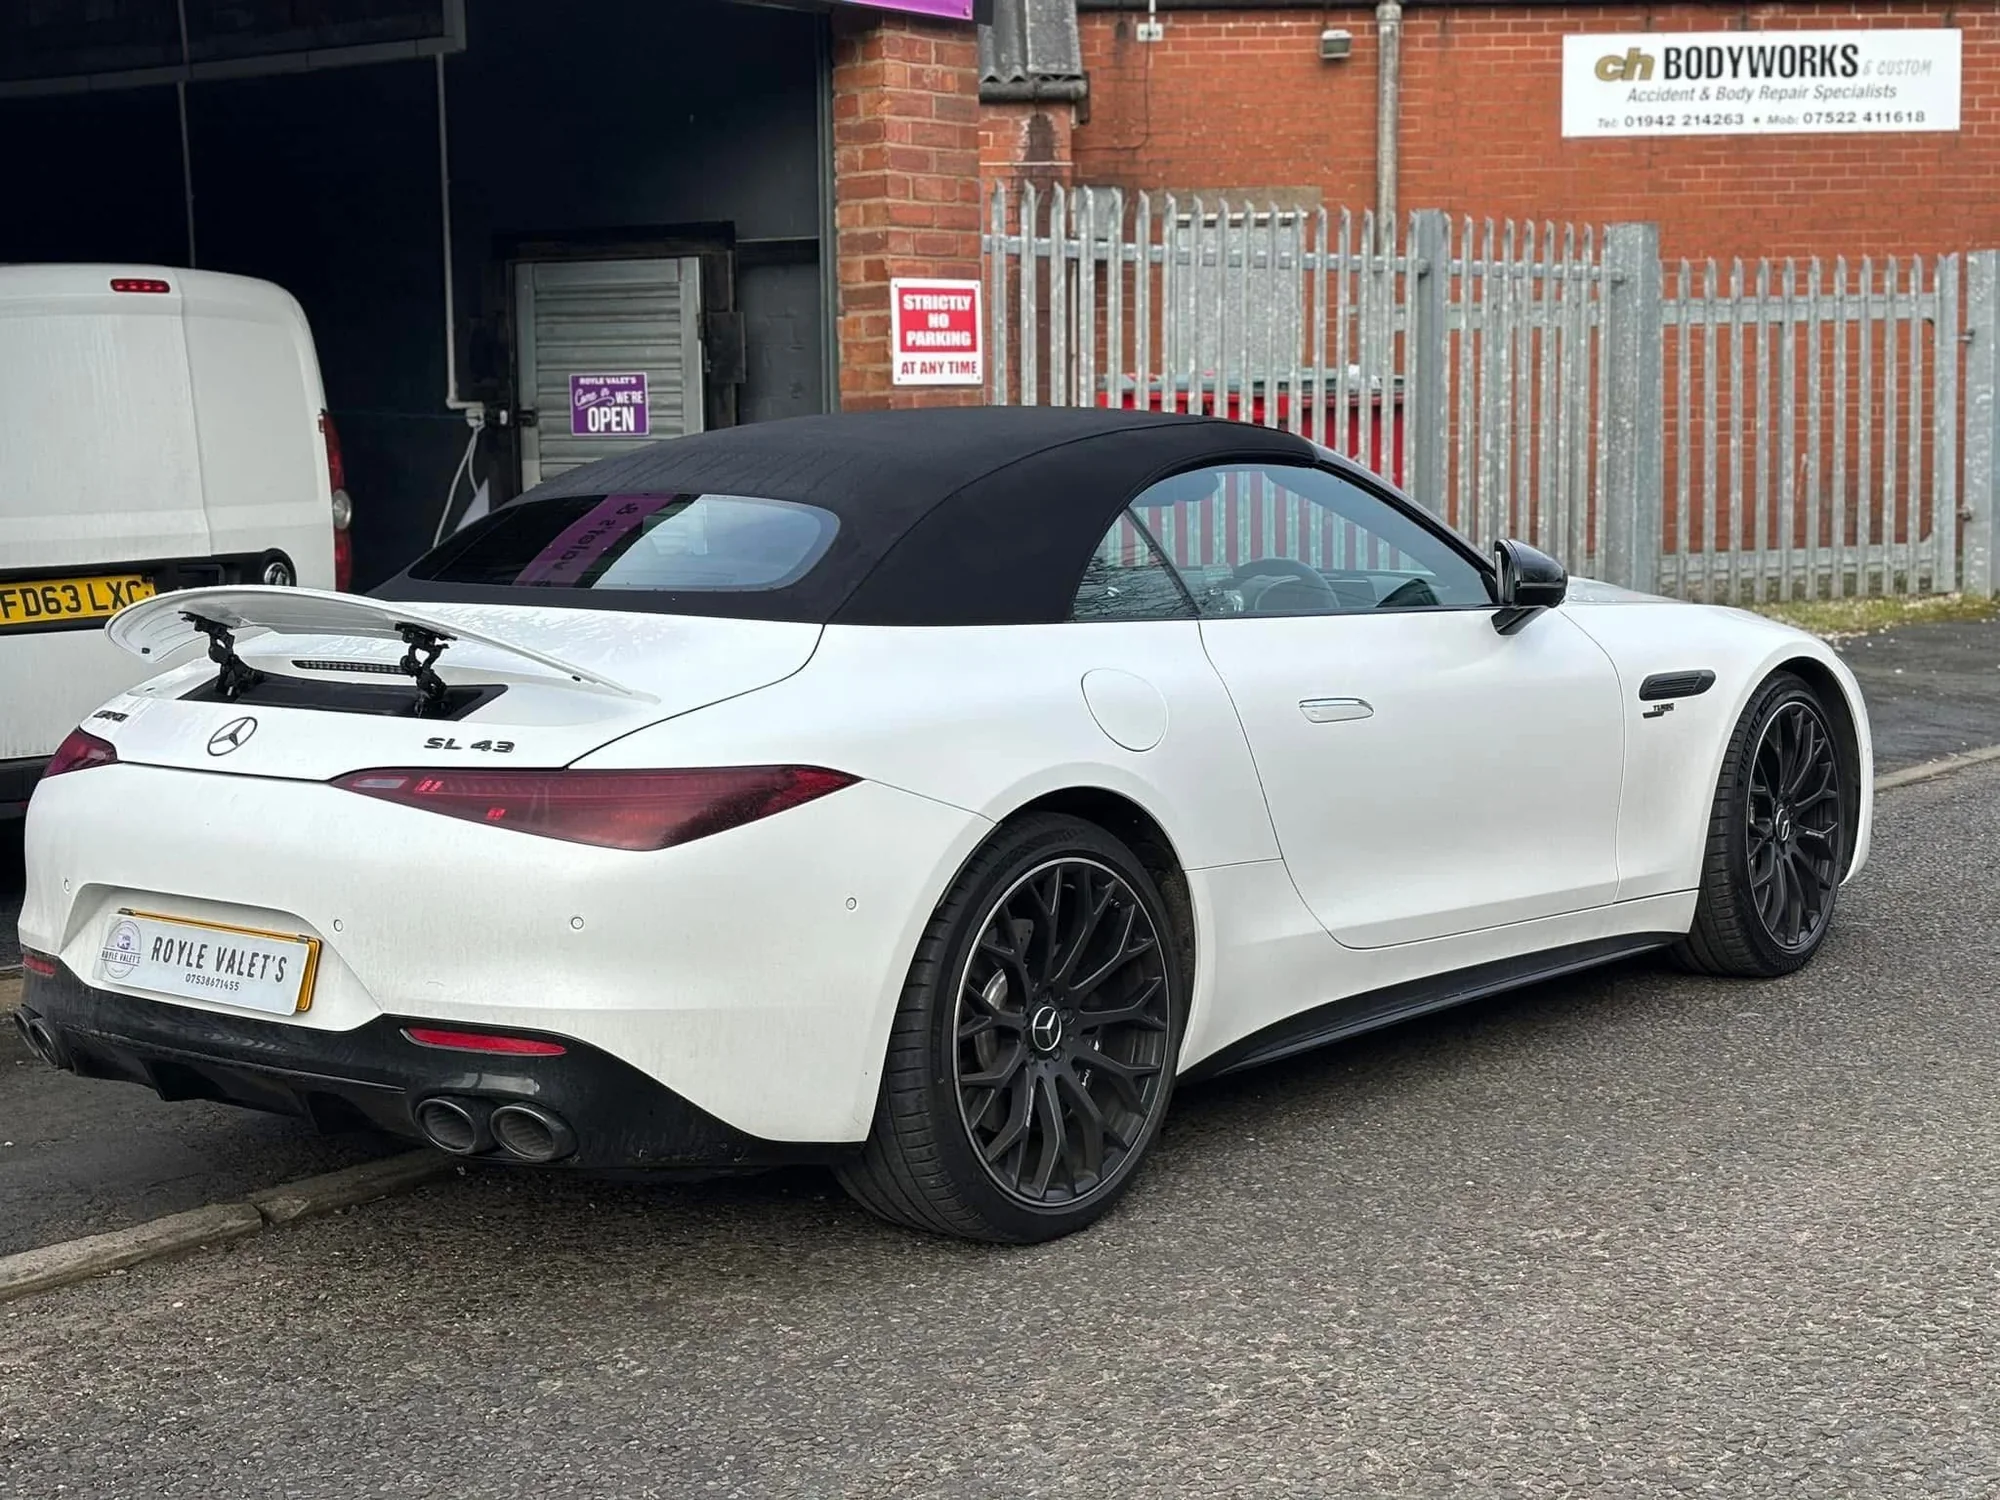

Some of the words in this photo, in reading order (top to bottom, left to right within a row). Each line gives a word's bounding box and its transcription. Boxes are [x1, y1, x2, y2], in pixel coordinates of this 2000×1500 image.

[1594, 47, 1656, 82] ch
[1663, 43, 1859, 81] BODYWORKS
[1877, 59, 1933, 76] CUSTOM
[1627, 87, 1696, 102] Accident
[1699, 86, 1710, 101] &
[1715, 85, 1755, 104] Body
[1758, 84, 1809, 102] Repair
[1813, 82, 1897, 103] Specialists
[1625, 114, 1676, 127] 01942
[1682, 113, 1744, 126] 214263
[1766, 113, 1799, 125] Mob:
[1803, 111, 1857, 125] 07522
[1863, 110, 1926, 124] 411618
[903, 294, 973, 311] STRICTLY
[927, 312, 950, 328] NO
[906, 330, 971, 347] PARKING
[901, 361, 916, 374] AT
[920, 360, 945, 374] ANY
[948, 360, 977, 374] TIME
[615, 390, 644, 404] WE'RE
[587, 406, 635, 432] OPEN
[0, 584, 82, 619] FD63
[423, 737, 463, 749] SL
[470, 740, 515, 753] 43
[151, 936, 208, 970] ROYLE
[215, 946, 288, 983] VALET'S
